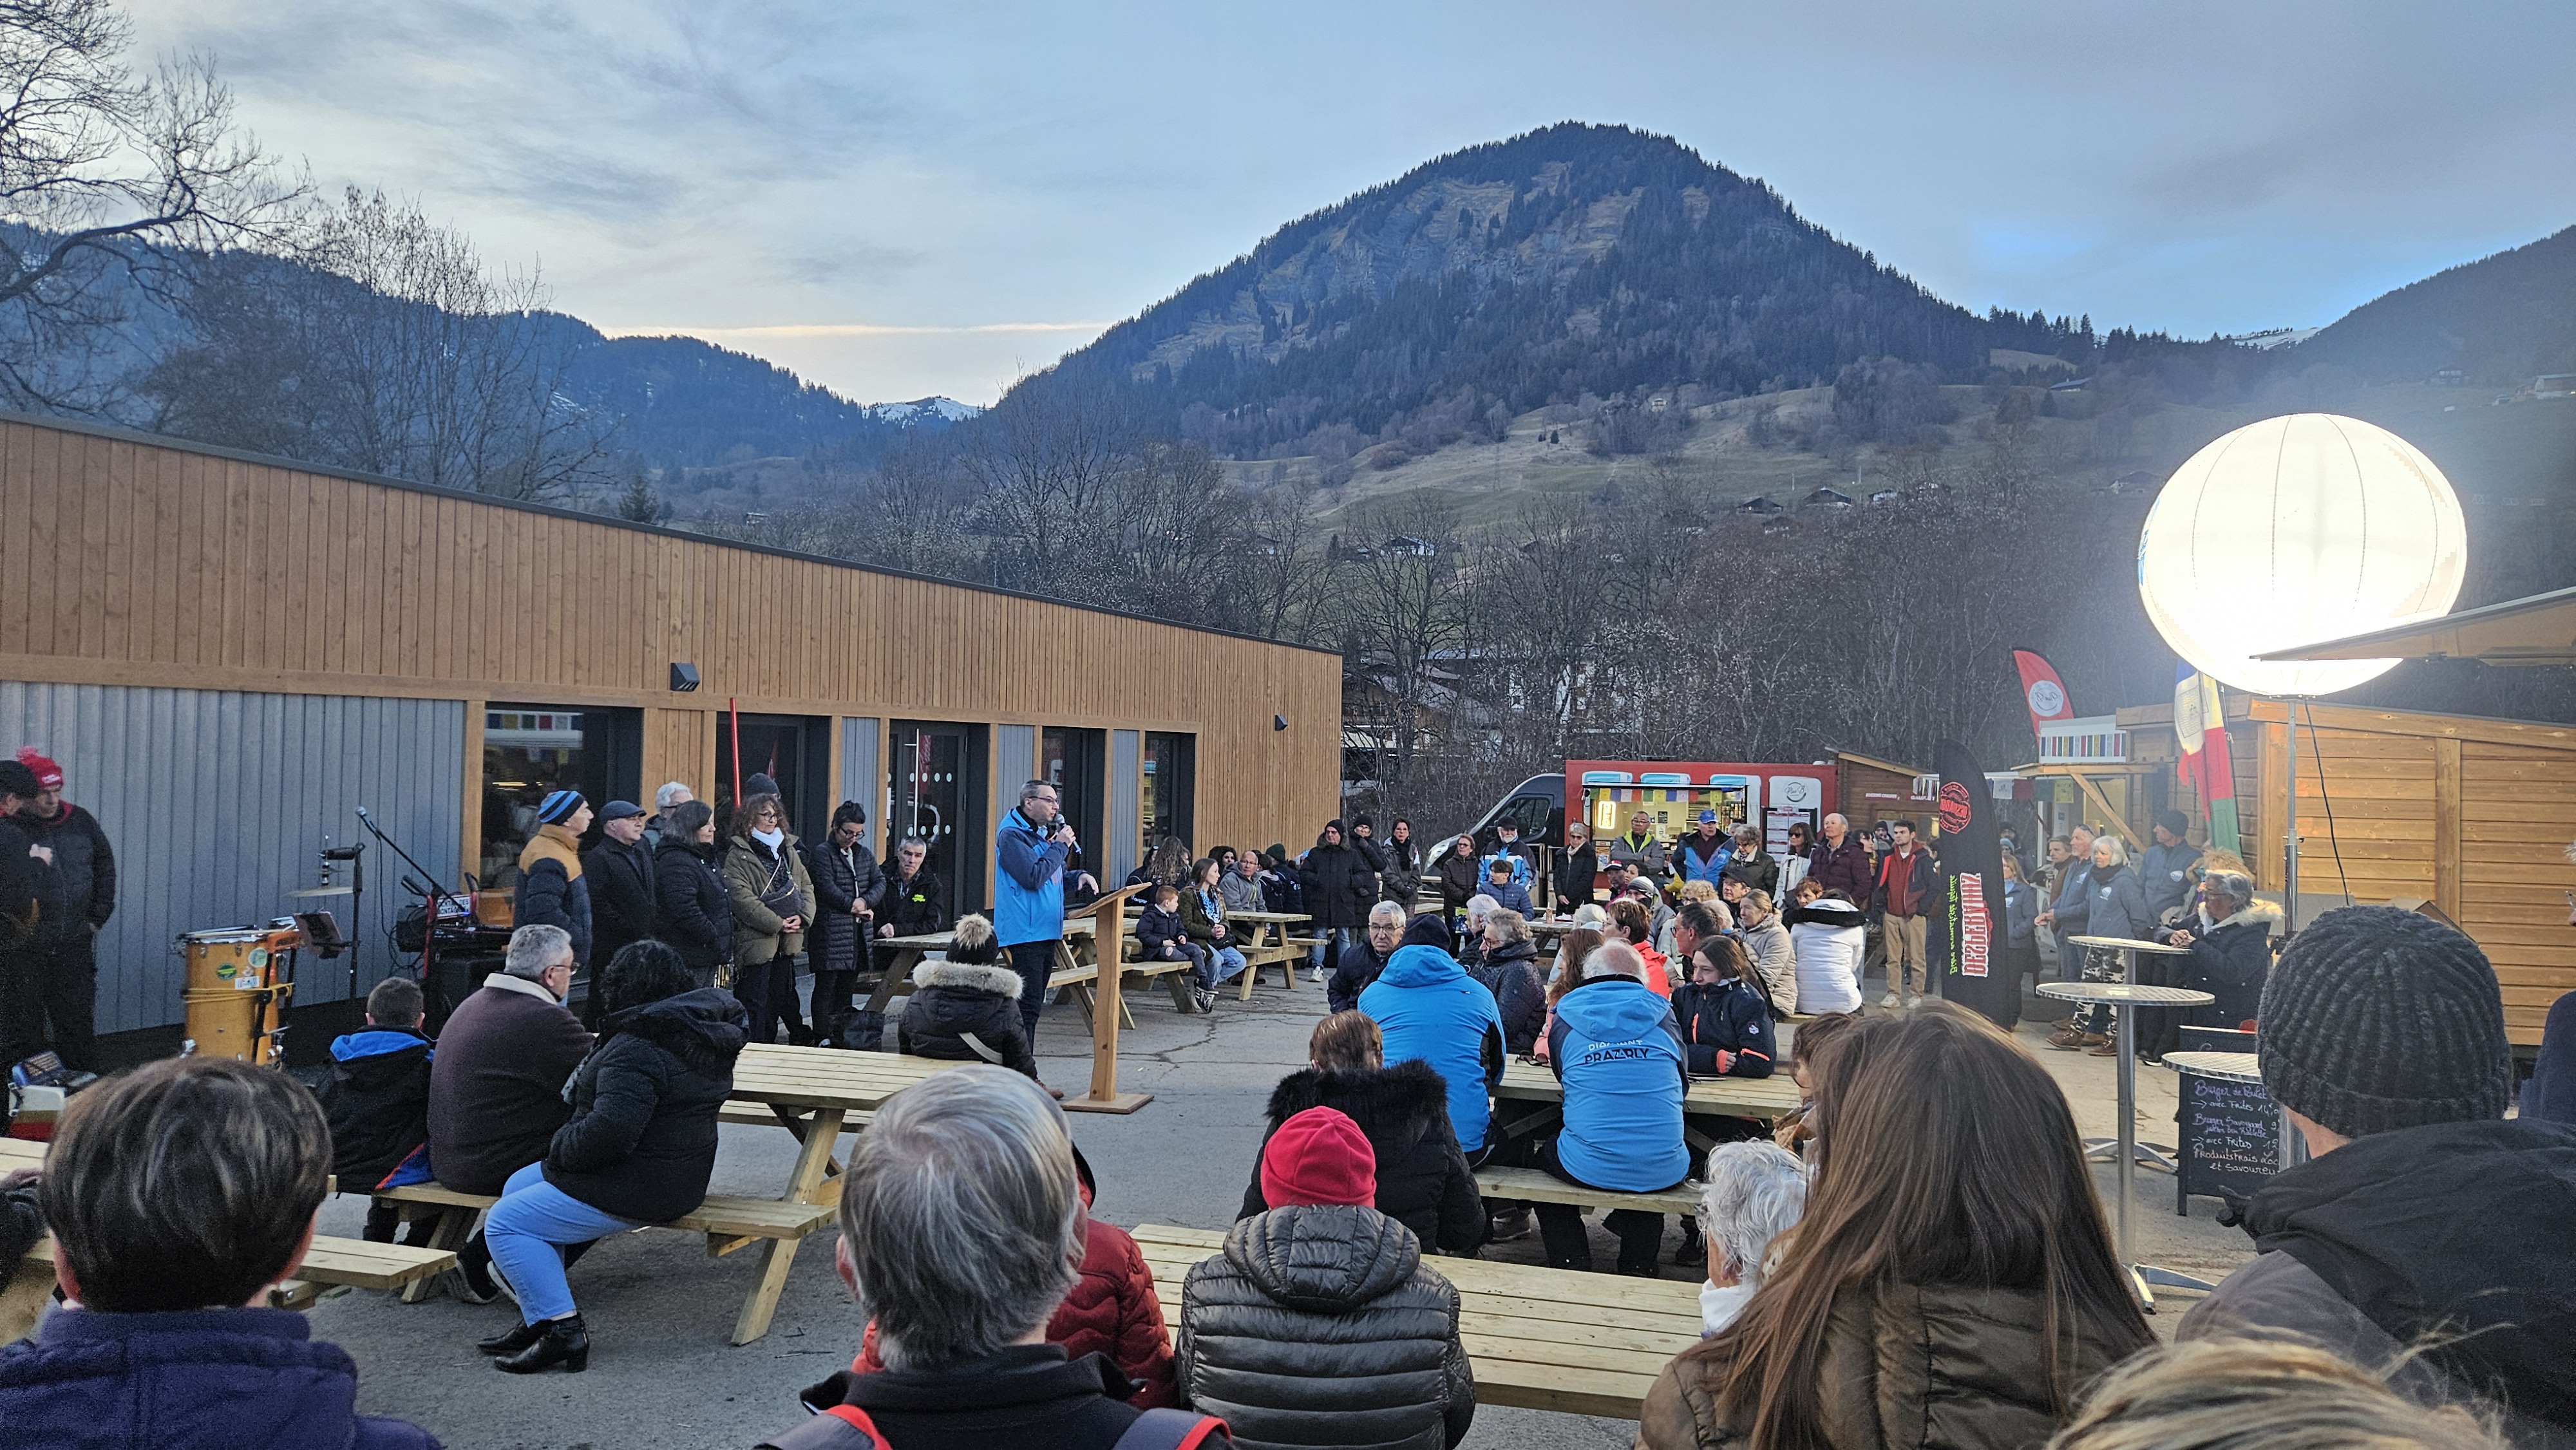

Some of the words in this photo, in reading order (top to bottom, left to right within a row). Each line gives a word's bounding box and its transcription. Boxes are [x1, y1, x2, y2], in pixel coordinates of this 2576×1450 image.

[2195, 1079, 2231, 1102] Burger
[2260, 1151, 2279, 1166] Loc
[2210, 1161, 2222, 1171] et
[2225, 1163, 2280, 1175] Savoureu
